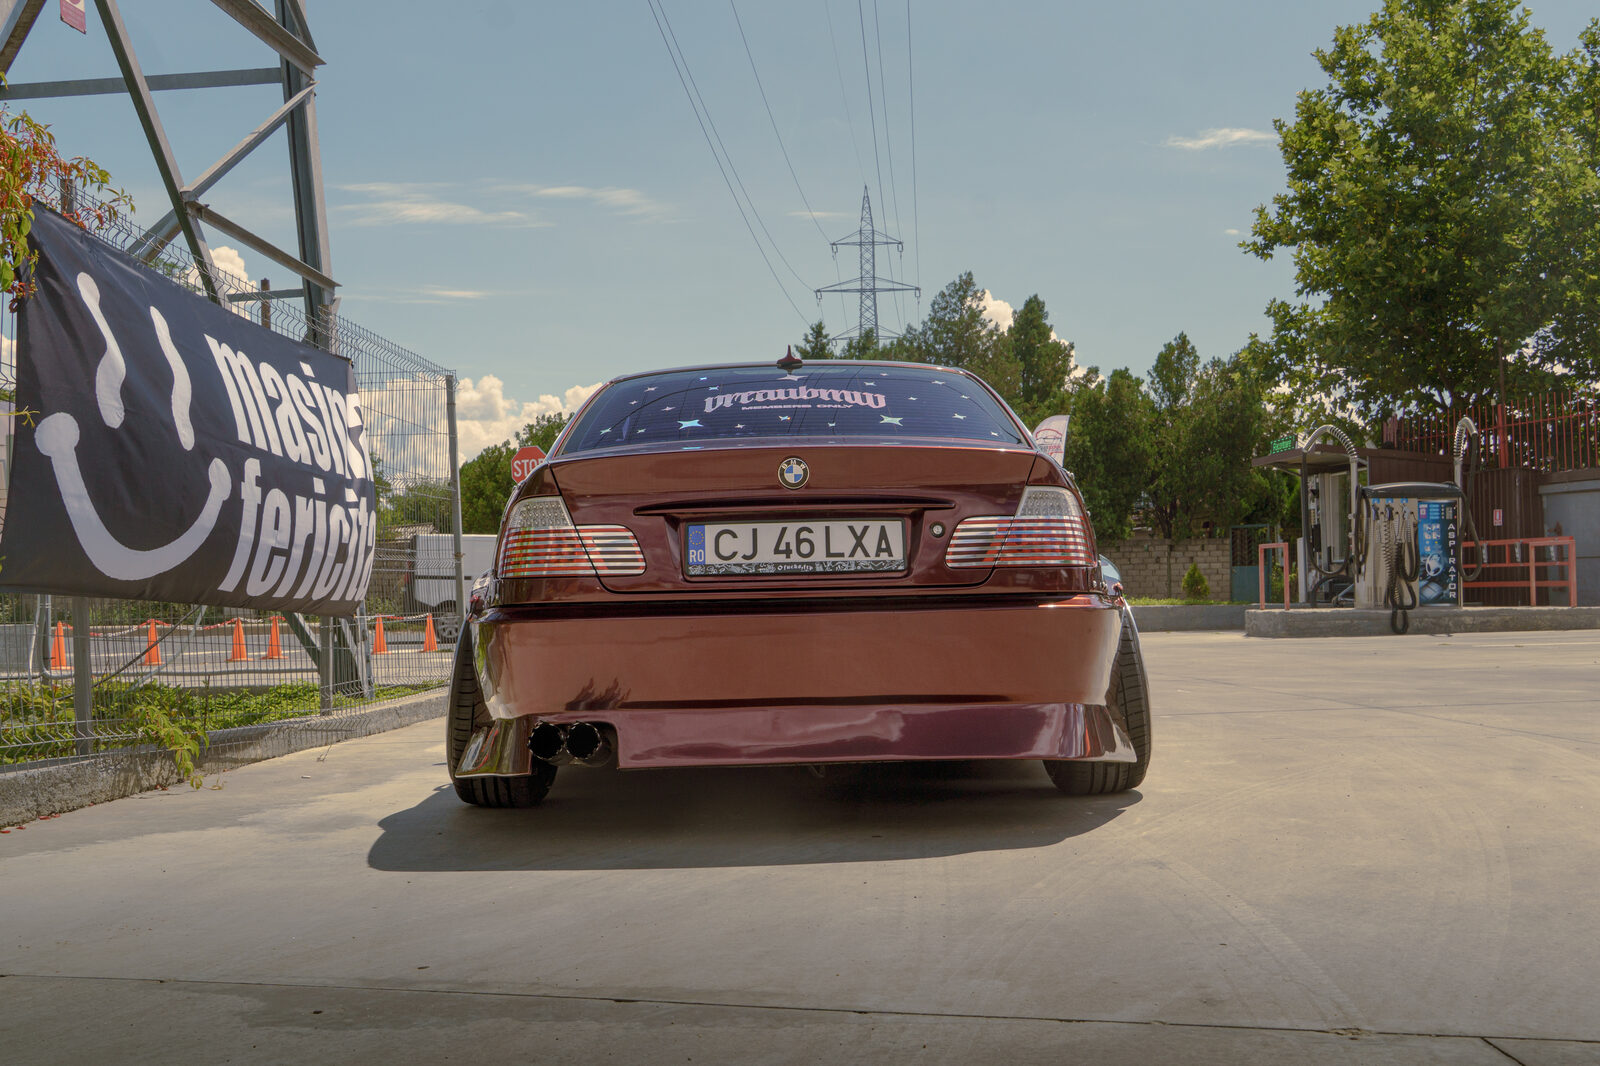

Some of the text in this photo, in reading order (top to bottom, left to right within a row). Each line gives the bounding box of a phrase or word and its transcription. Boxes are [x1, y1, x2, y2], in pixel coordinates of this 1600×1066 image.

[689, 549, 705, 563] RO
[714, 525, 894, 561] CJ 46 LXA
[1447, 523, 1457, 598] ASPIRATOR
